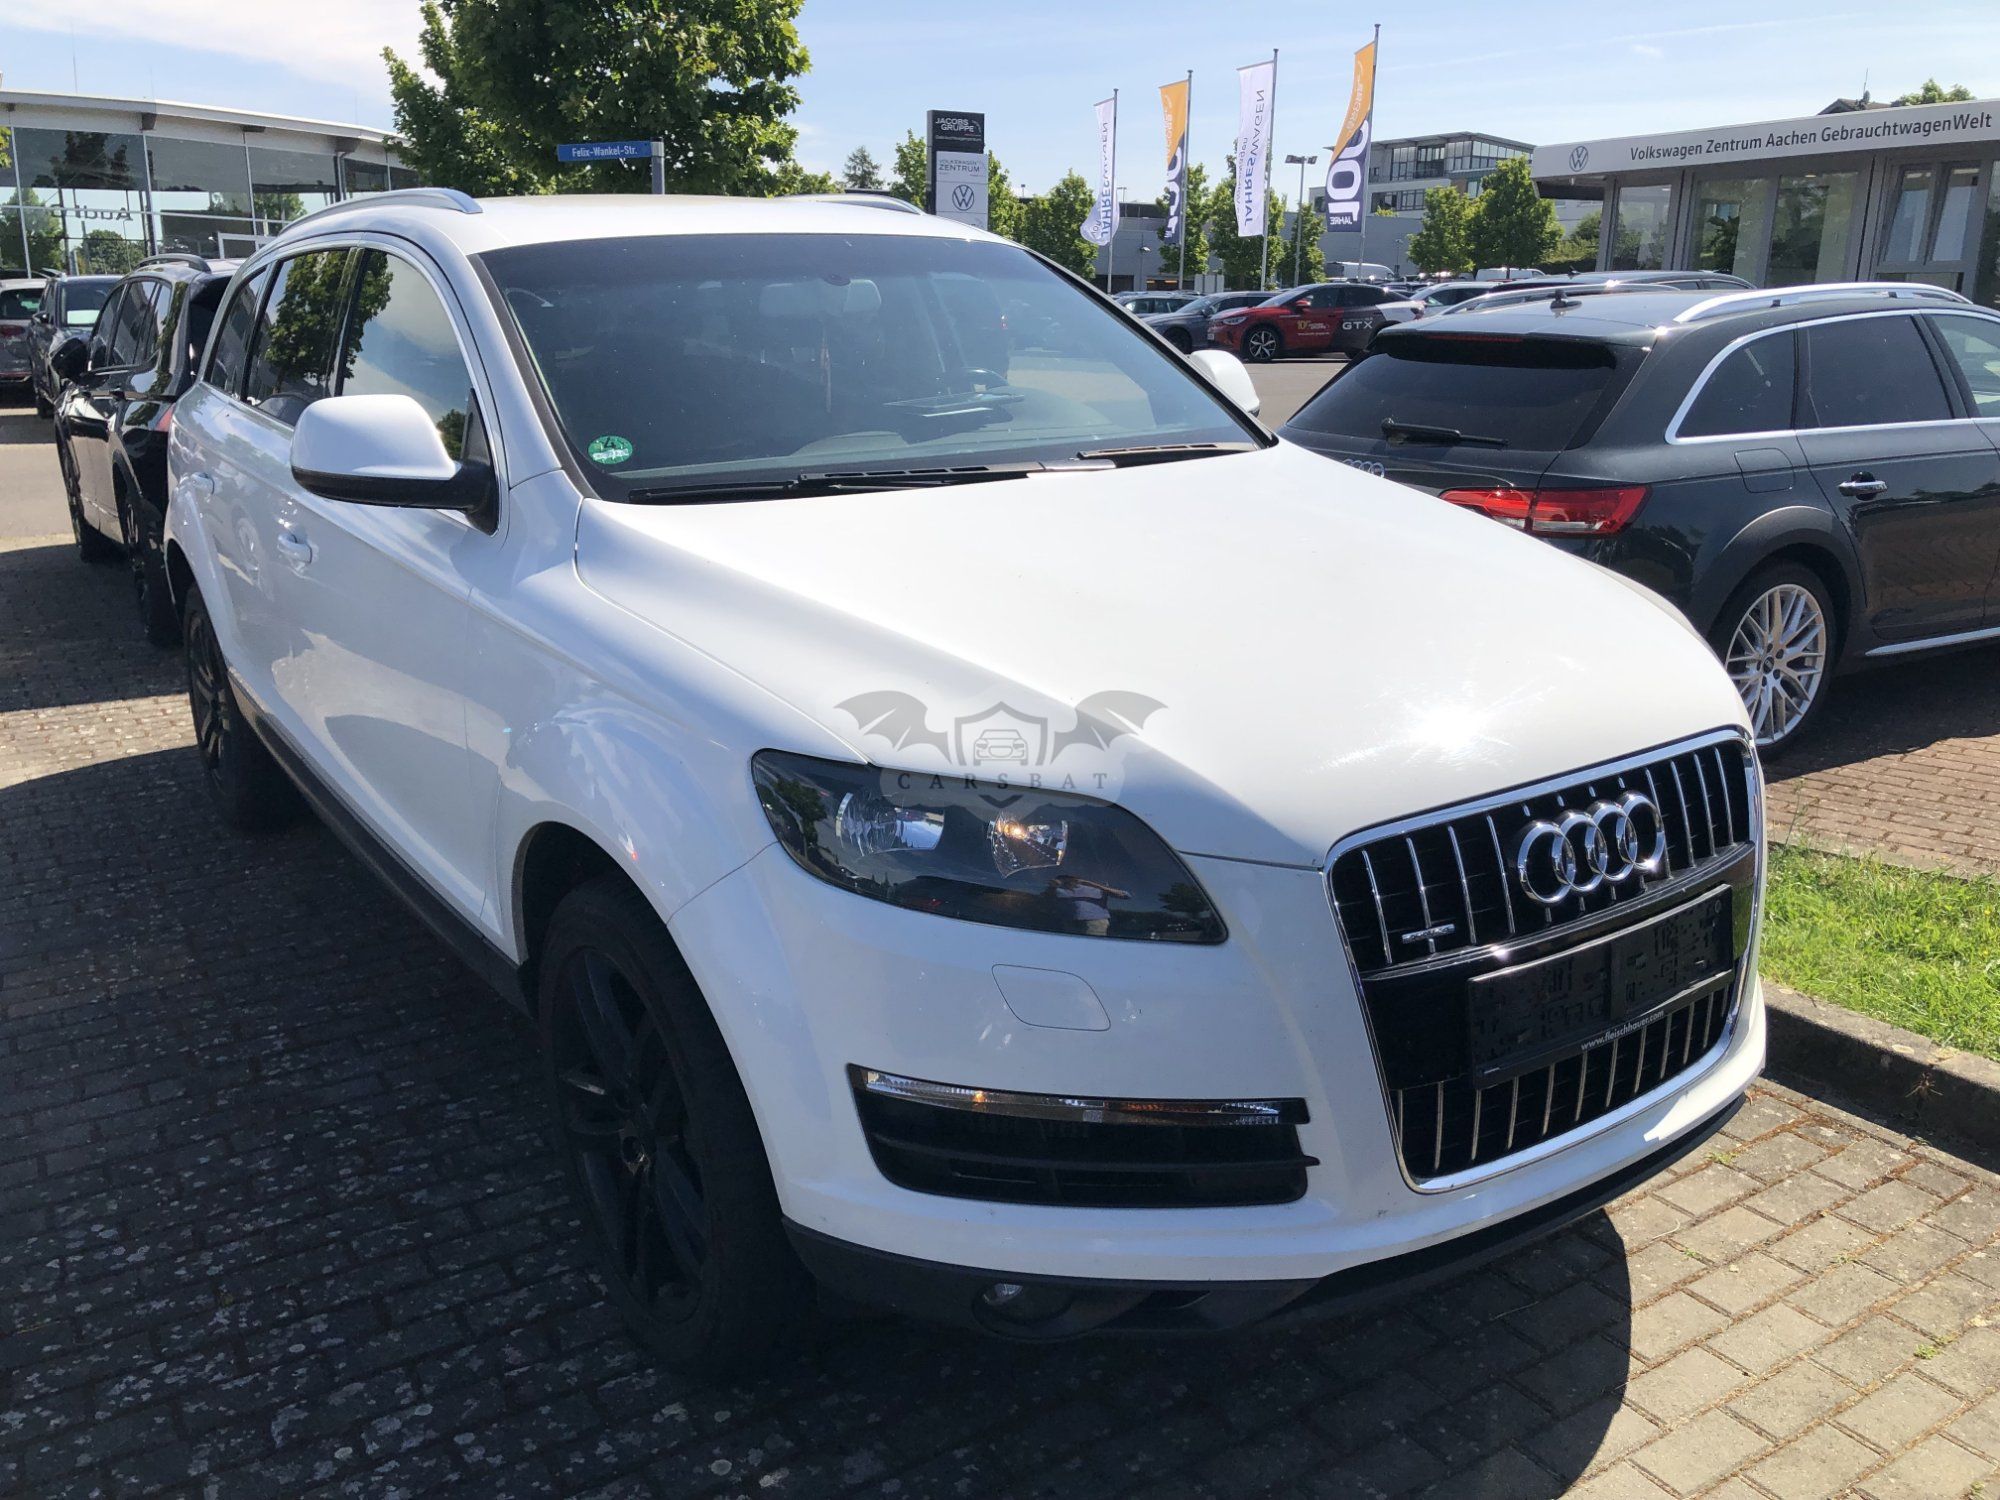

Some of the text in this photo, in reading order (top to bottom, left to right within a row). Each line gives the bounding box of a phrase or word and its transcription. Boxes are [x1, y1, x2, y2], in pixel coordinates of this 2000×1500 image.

[935, 117, 969, 126] JACOBS
[940, 124, 975, 133] GRUPPE
[1630, 143, 1702, 160] Volkswagen
[1706, 137, 1762, 154] Zentrum
[1766, 131, 1817, 148] Aachen
[572, 145, 638, 157] Felix-Wankel-Str.
[938, 164, 980, 173] ZENTRUM
[1342, 320, 1373, 330] GTX
[1581, 1010, 1665, 1051] www.fleischhauer.com
